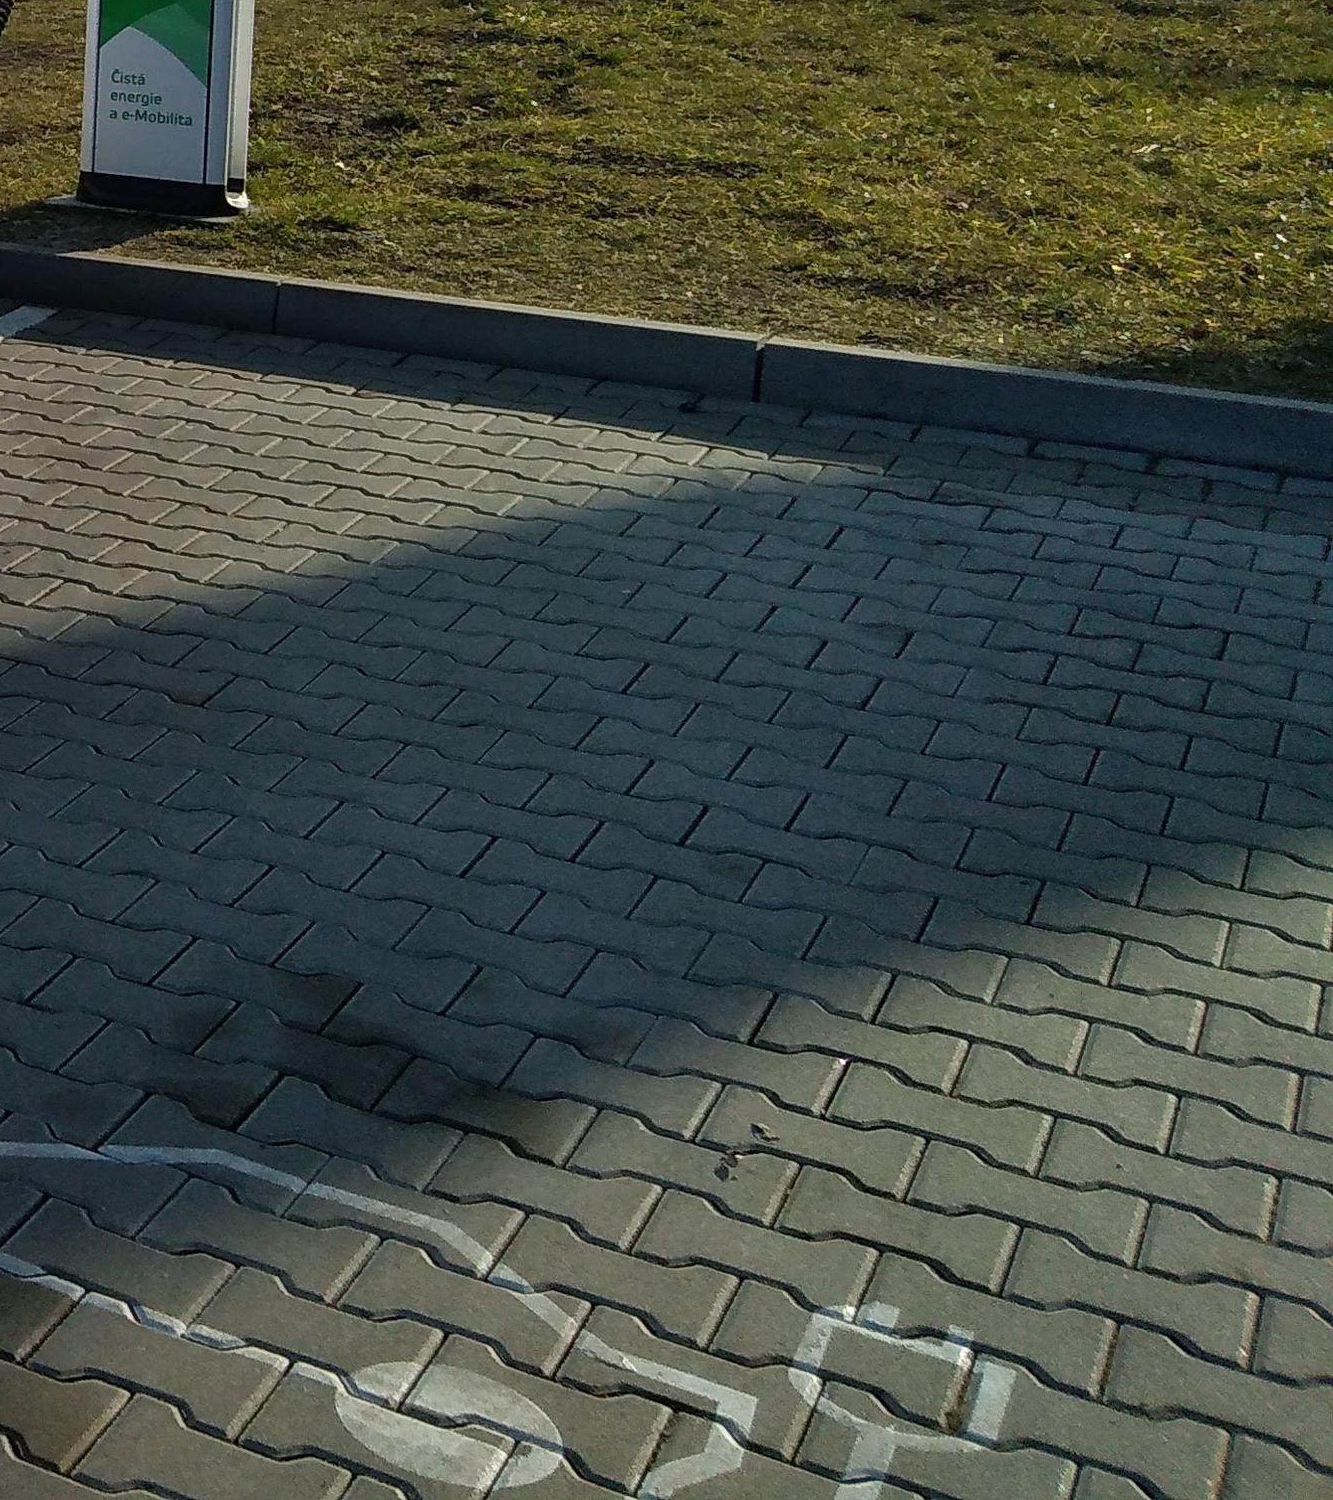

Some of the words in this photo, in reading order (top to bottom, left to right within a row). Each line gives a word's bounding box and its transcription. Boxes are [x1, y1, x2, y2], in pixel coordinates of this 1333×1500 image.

[110, 68, 146, 86] Čistá
[110, 91, 163, 107] energie
[109, 109, 118, 120] a
[121, 108, 193, 127] e-Mobilita
